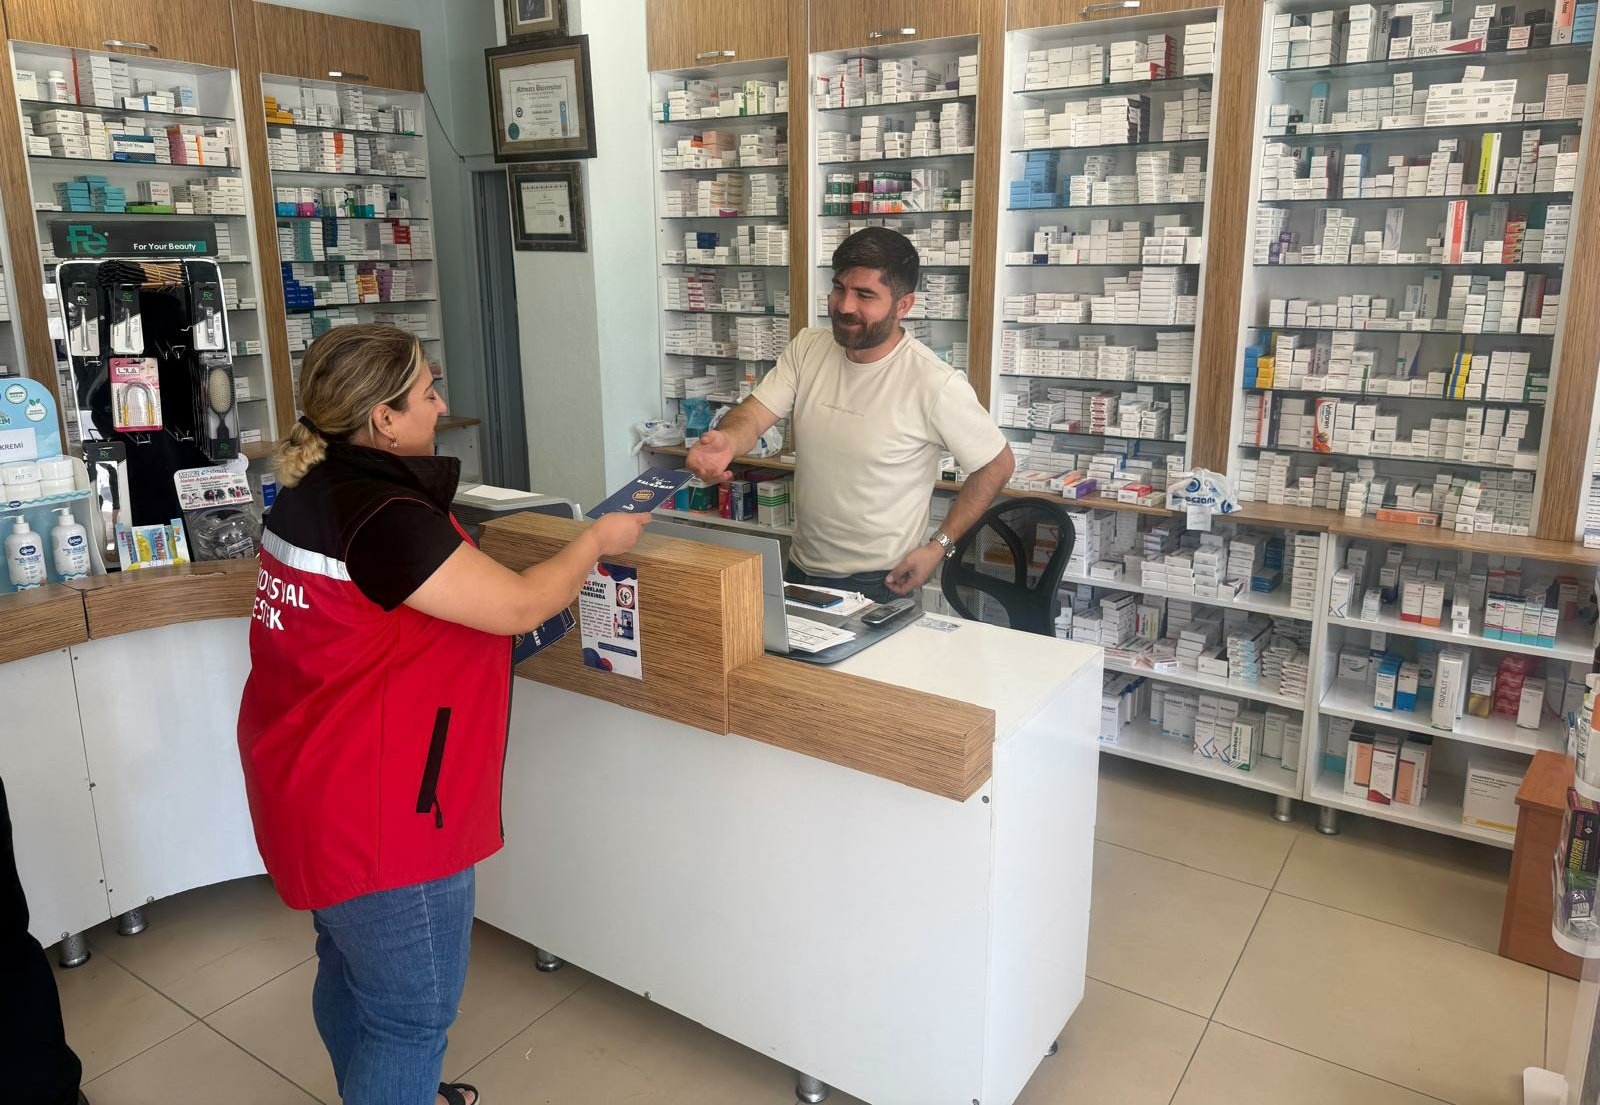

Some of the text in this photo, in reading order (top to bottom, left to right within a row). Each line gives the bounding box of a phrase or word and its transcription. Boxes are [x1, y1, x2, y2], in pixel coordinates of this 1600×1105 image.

[133, 243, 196, 251] For Your Beauty
